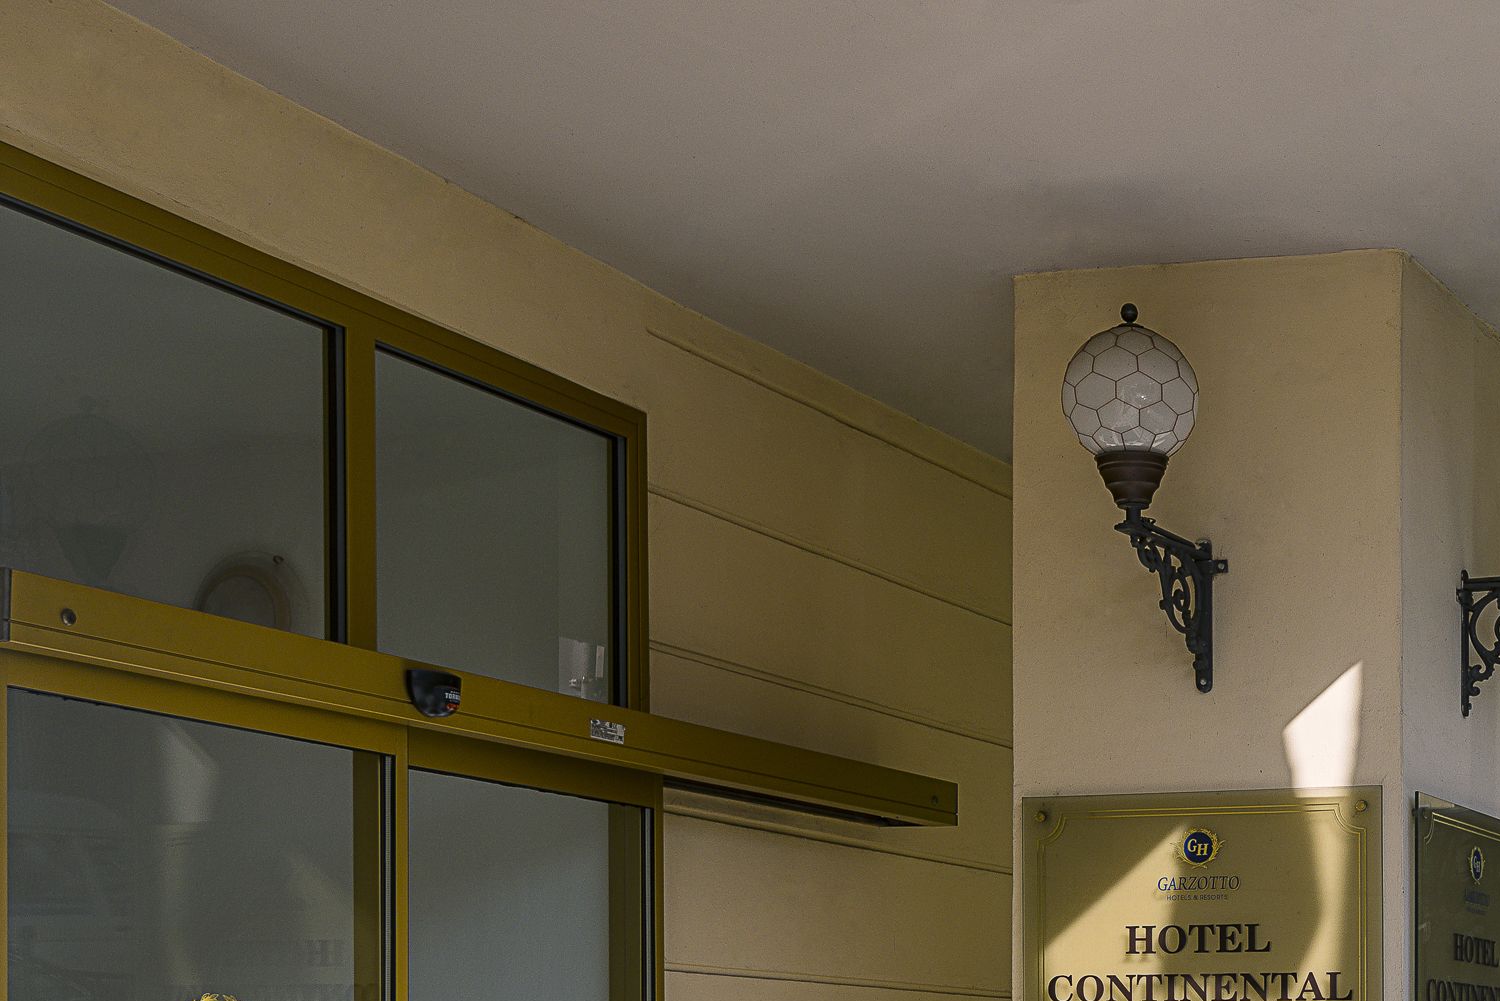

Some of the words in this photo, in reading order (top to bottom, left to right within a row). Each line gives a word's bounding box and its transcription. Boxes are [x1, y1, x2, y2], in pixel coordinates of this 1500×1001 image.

[1187, 838, 1209, 856] GH
[1157, 876, 1240, 891] GARZOTTO
[1126, 923, 1271, 955] HOTEL
[1453, 933, 1500, 968] HOTEL
